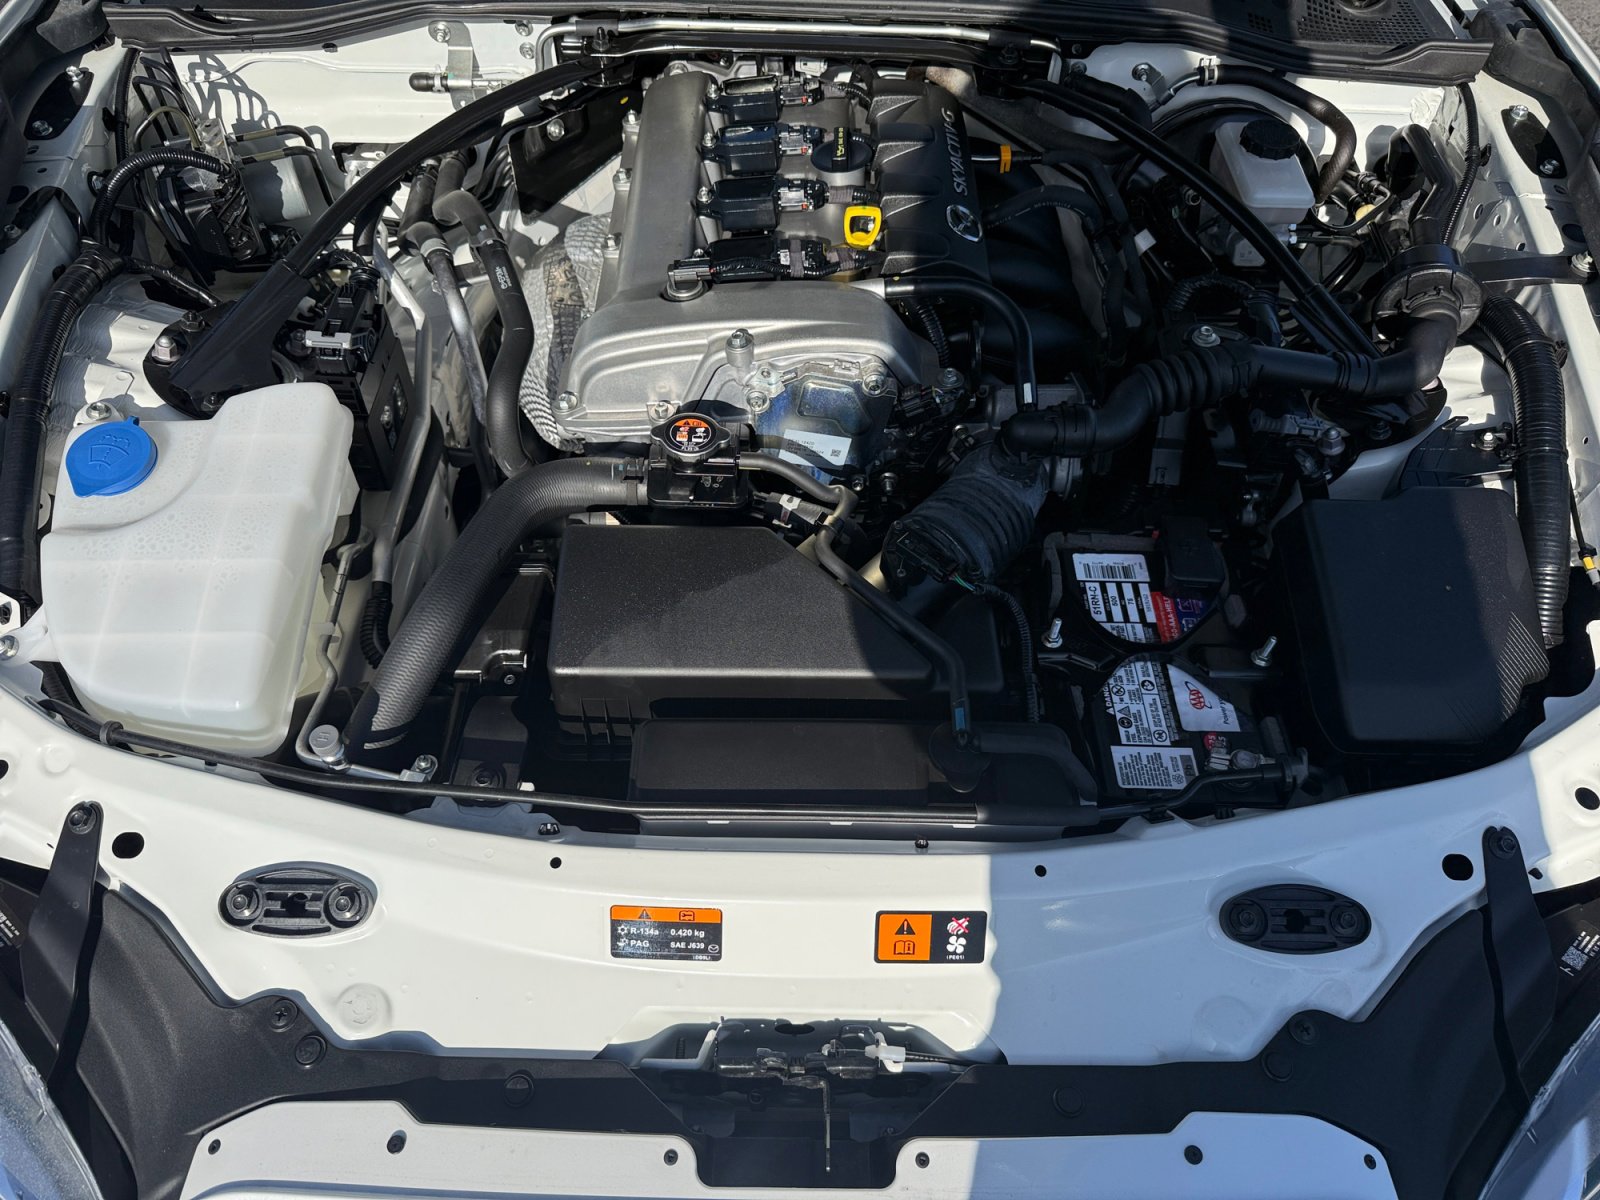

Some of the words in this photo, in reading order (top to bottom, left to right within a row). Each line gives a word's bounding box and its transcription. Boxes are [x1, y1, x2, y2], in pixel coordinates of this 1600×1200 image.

[1088, 585, 1102, 616] 51RN-C
[1110, 596, 1118, 607] 500
[1102, 681, 1112, 706] DANG
[1190, 690, 1205, 709] AAA
[630, 927, 659, 935] R-134a
[670, 928, 692, 936] 0.420
[694, 929, 705, 938] kg
[630, 939, 649, 947] PAG
[670, 941, 686, 949] SAE
